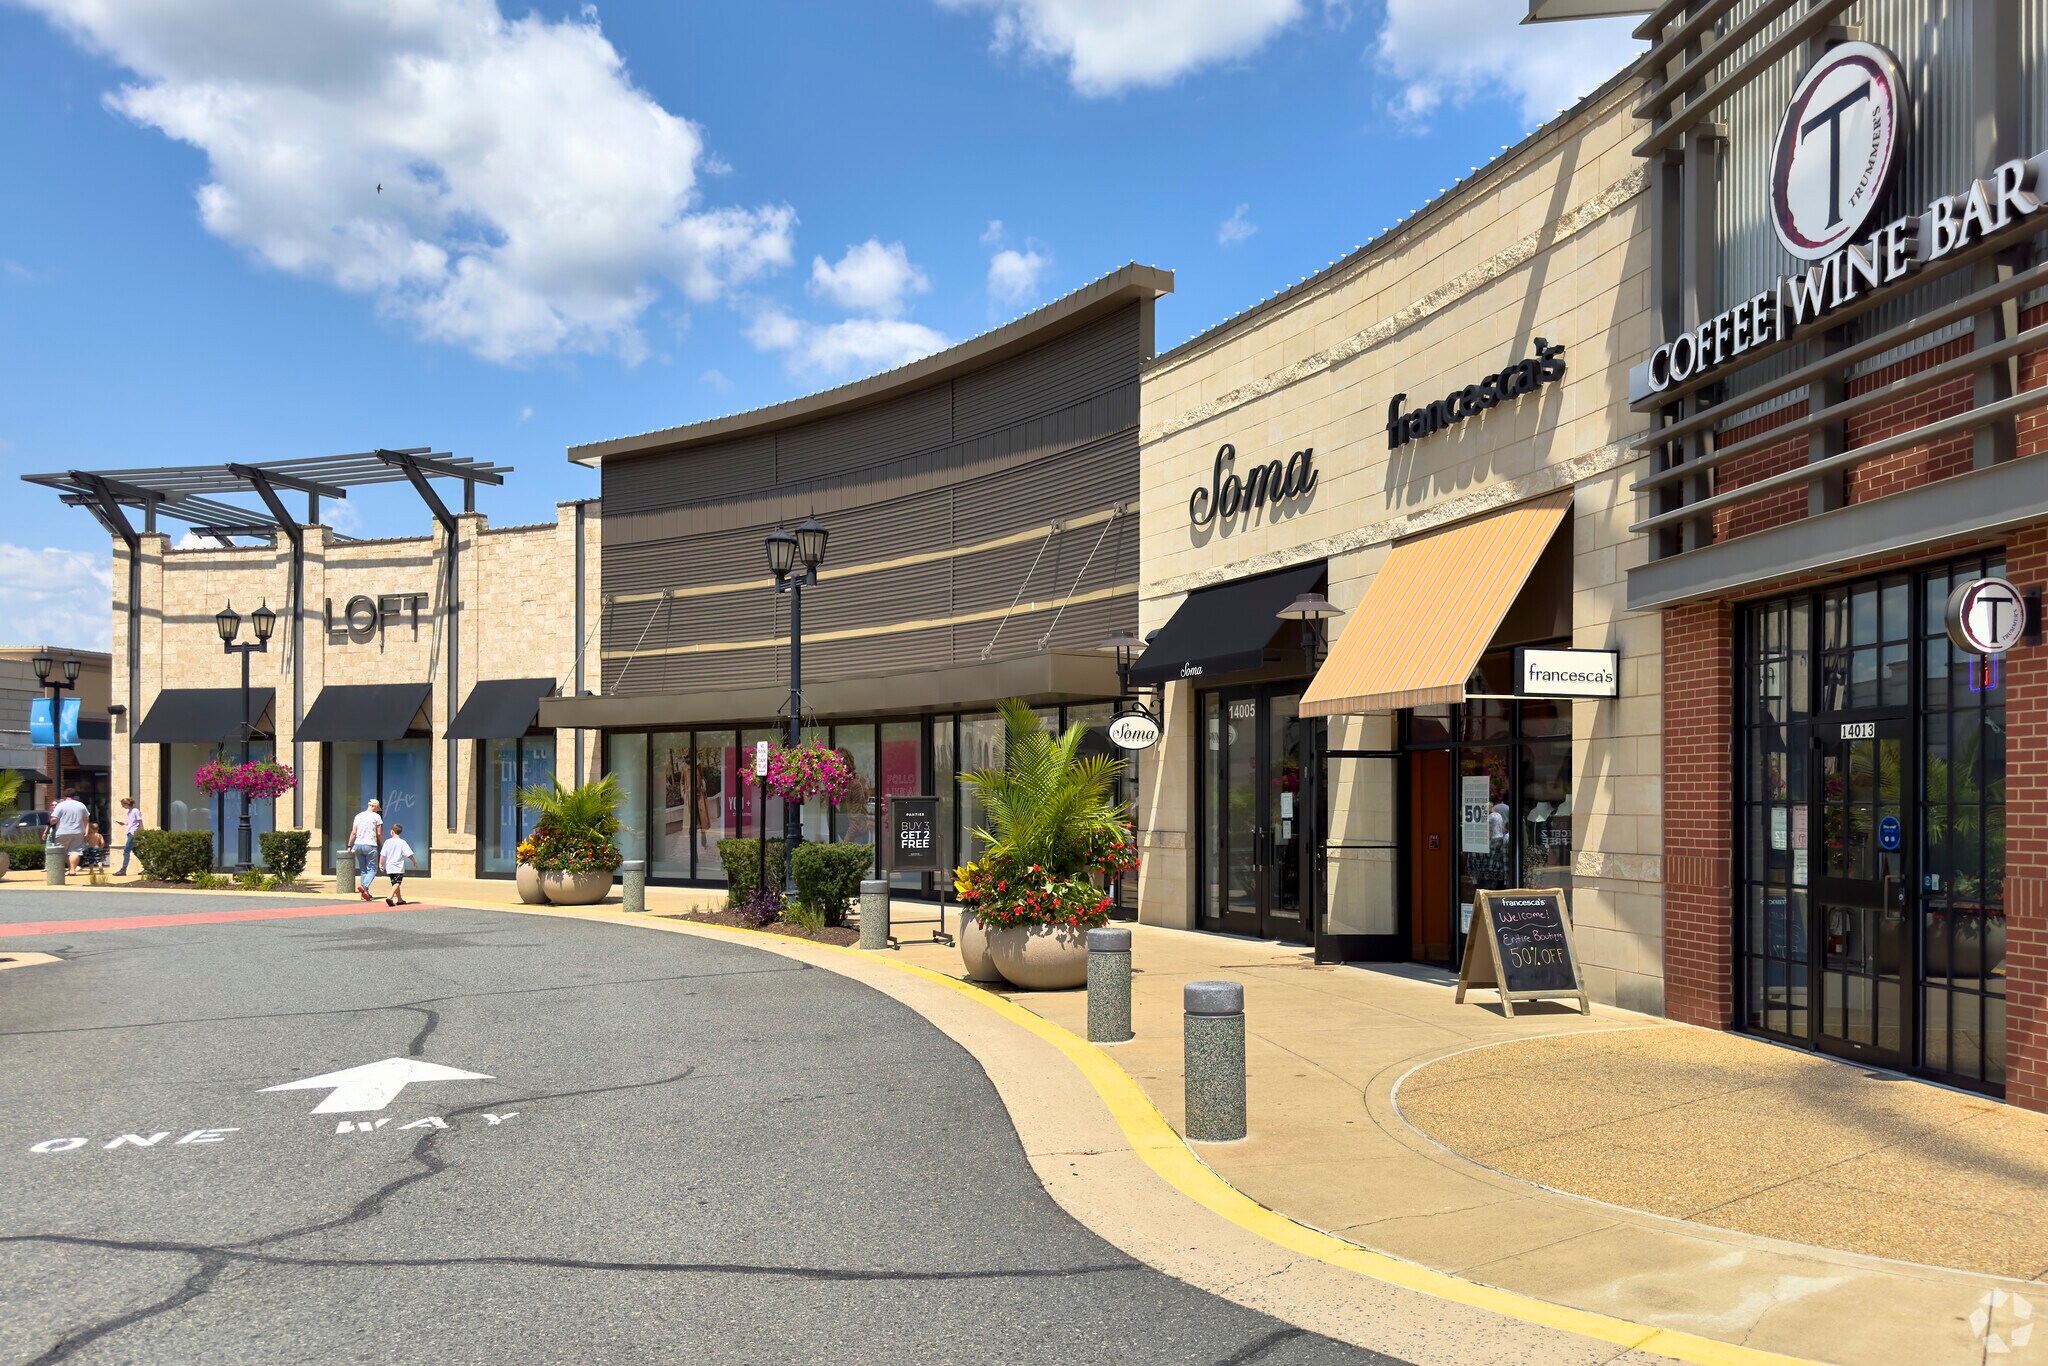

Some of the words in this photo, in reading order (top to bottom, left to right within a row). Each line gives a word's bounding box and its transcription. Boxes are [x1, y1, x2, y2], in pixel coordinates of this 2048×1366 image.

[1800, 81, 1871, 231] T
[1847, 105, 1882, 208] TRUMMER'S
[1648, 289, 1773, 392] COFFEE
[1785, 220, 1910, 325] WINE
[1928, 158, 2040, 262] BAR
[1385, 336, 1567, 450] francesca's
[1189, 443, 1319, 526] Soma
[325, 592, 428, 634] LOFT
[1977, 597, 2012, 643] T
[1180, 661, 1203, 678] Soma
[1529, 662, 1614, 685] francesca's
[1229, 703, 1256, 719] 14005
[1112, 722, 1157, 742] Soma
[1841, 724, 1875, 739] 14013
[900, 831, 922, 840] GET
[923, 831, 930, 840] 2
[901, 821, 922, 831] BUY
[924, 821, 930, 831] 3
[901, 840, 930, 849] FREE
[1502, 897, 1546, 907] francesca's
[1499, 909, 1550, 923] Welcome!
[1503, 933, 1532, 946] Entire
[335, 1111, 520, 1135] WAY
[30, 1127, 241, 1154] ONE
